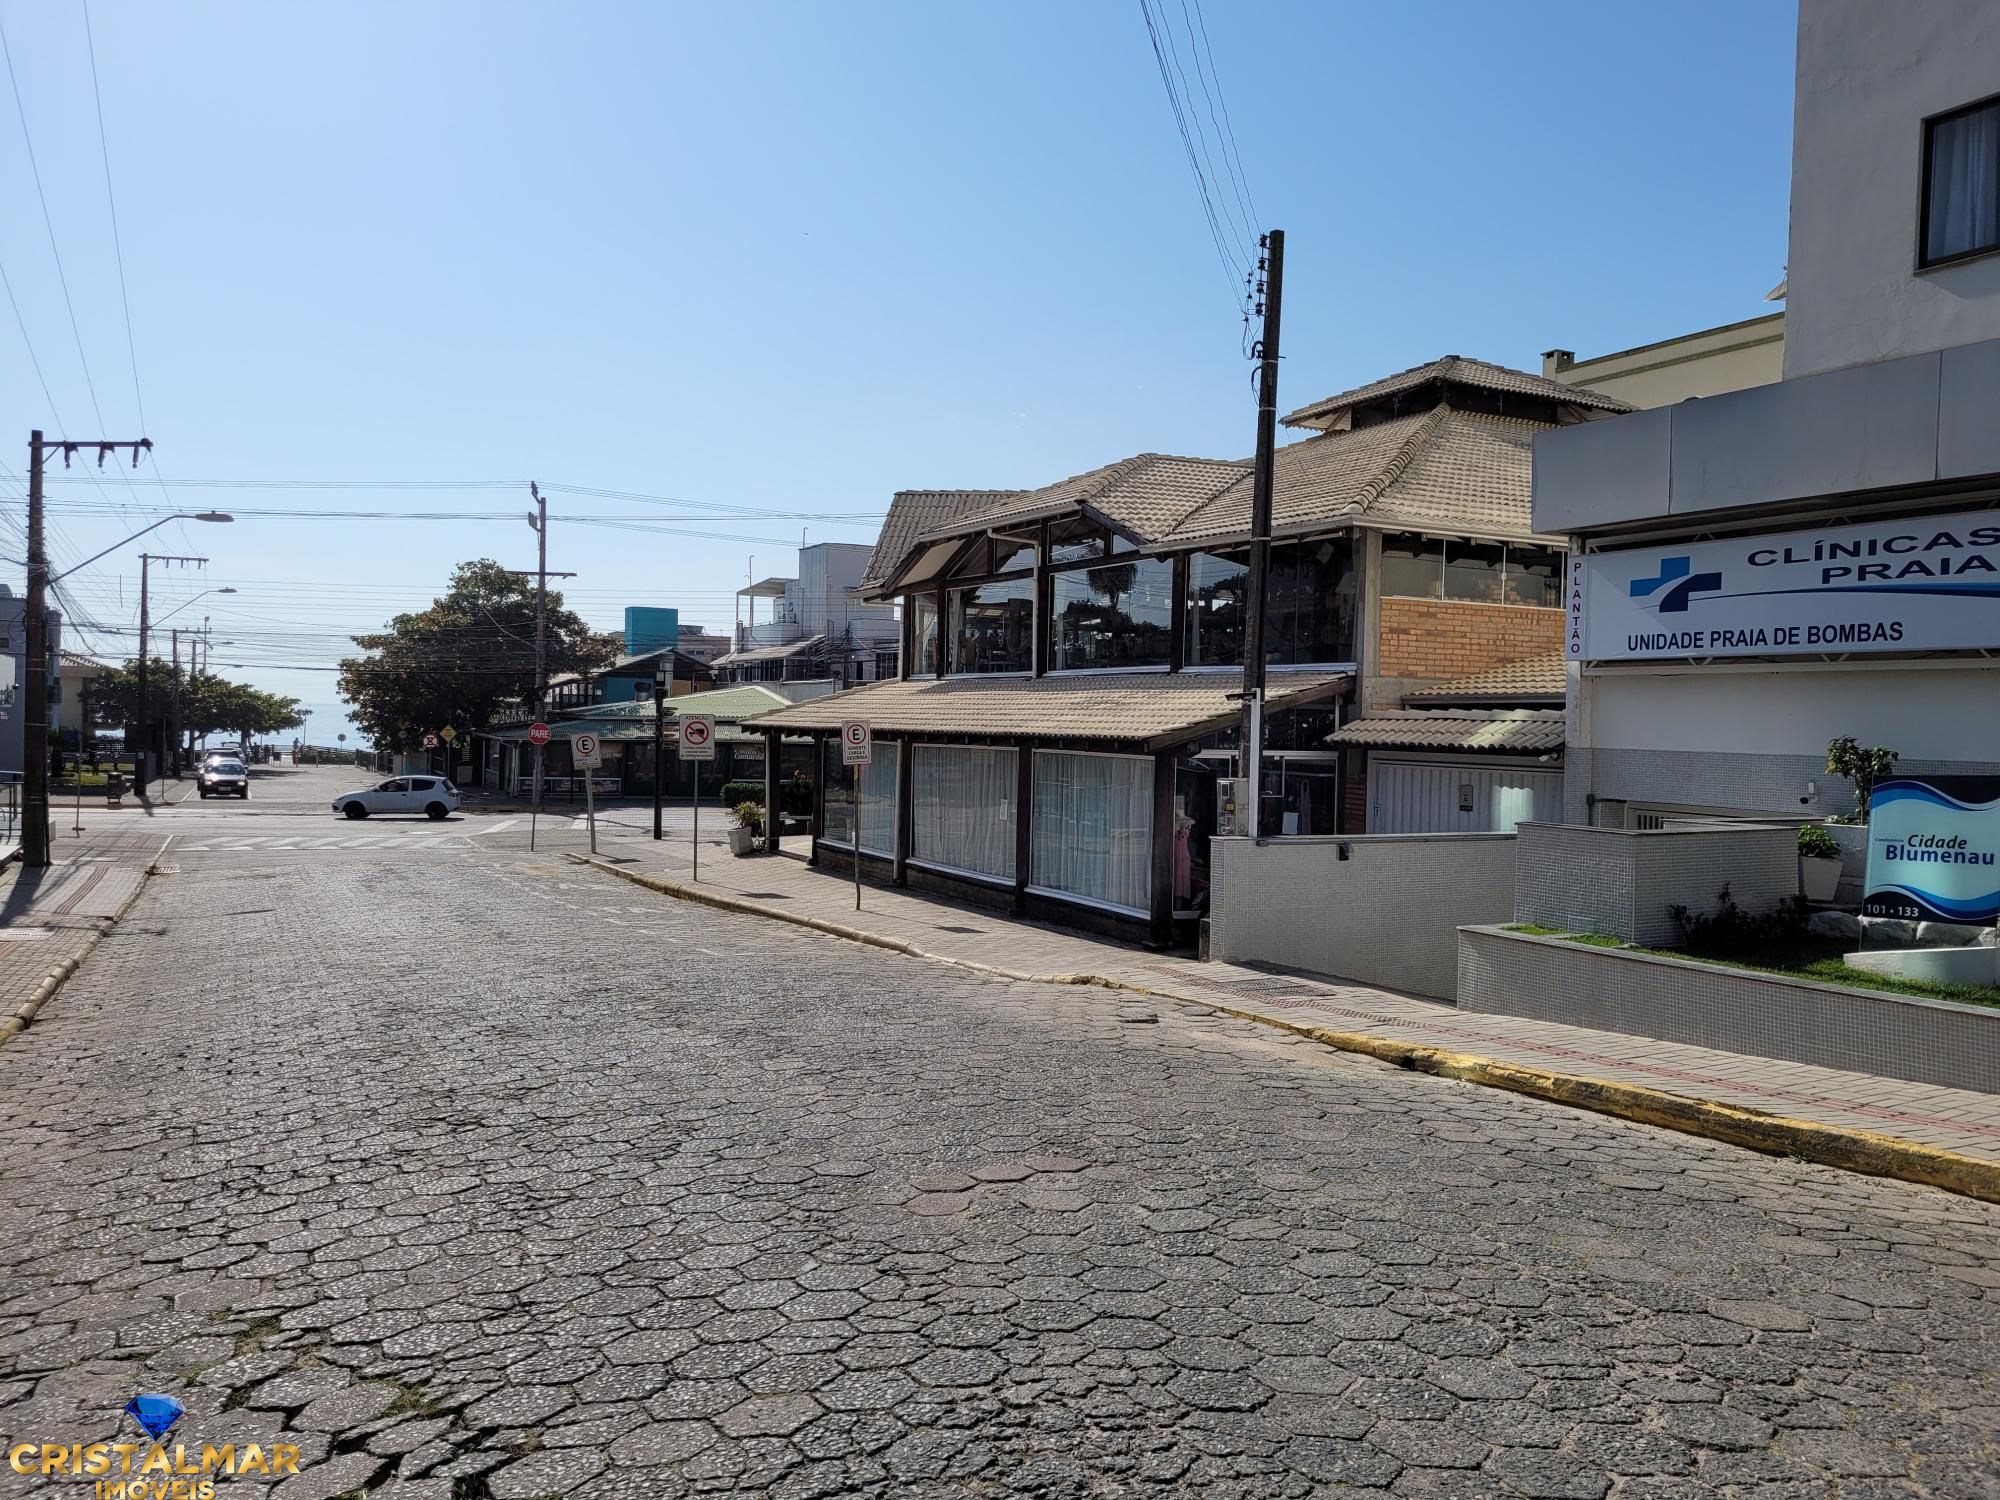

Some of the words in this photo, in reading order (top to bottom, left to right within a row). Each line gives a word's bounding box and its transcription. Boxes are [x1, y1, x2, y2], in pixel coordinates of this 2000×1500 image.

[1747, 527, 2000, 567] CLÍNICAS
[1821, 554, 1999, 585] PRAIA
[1570, 562, 1582, 654] PLANTÃO
[1627, 631, 1704, 651] UNIDADE
[1710, 628, 1768, 648] PRAIA
[1773, 626, 1801, 646] DE
[1806, 621, 1904, 645] BOMBAS
[530, 729, 549, 739] PARE
[852, 728, 860, 741] E
[581, 739, 590, 751] E
[1907, 834, 1968, 850] Cidade
[1885, 844, 1995, 866] Blumenau
[1866, 904, 1887, 915] 101
[1897, 906, 1919, 918] 133
